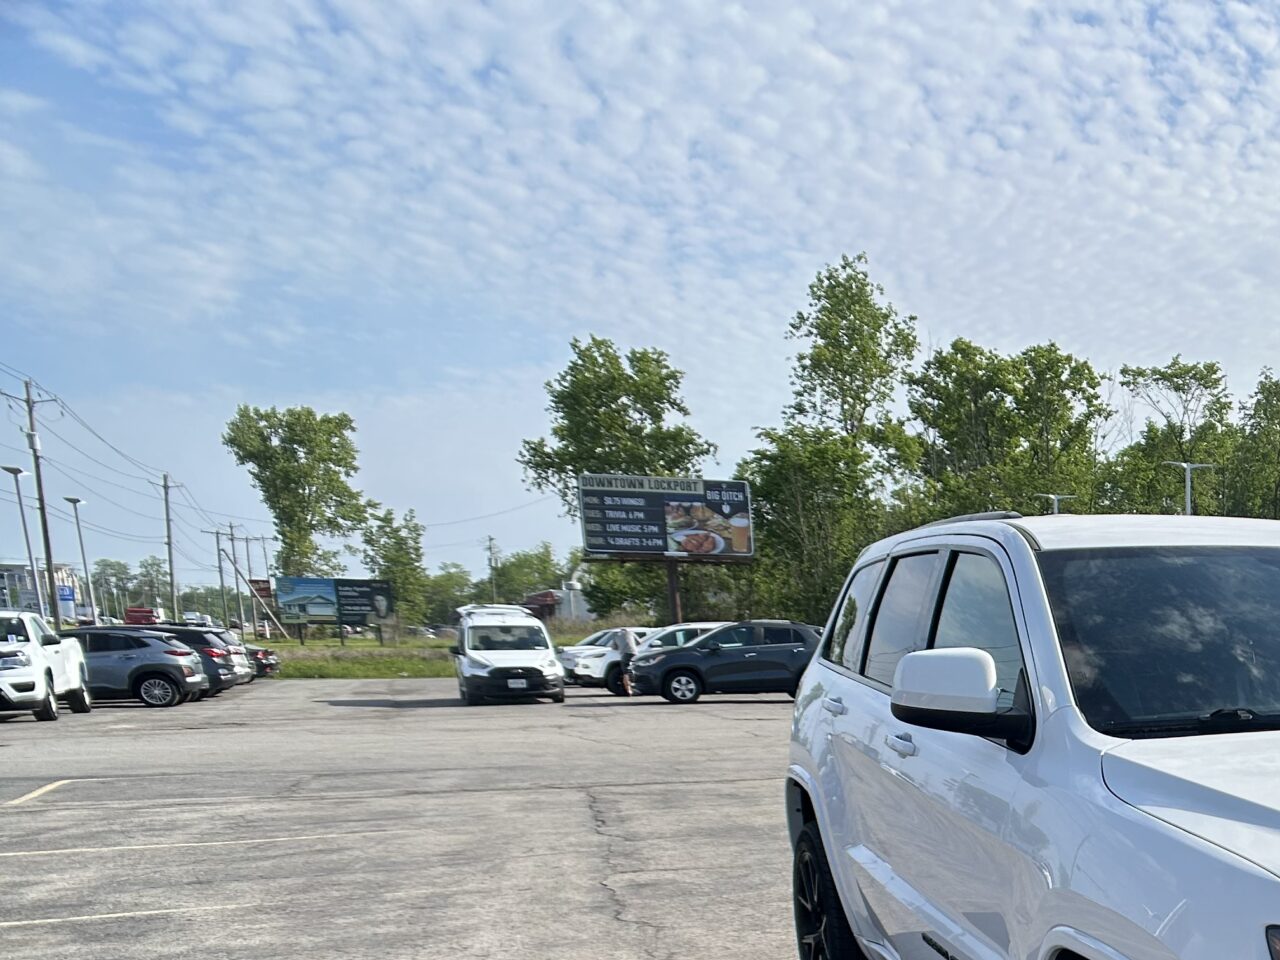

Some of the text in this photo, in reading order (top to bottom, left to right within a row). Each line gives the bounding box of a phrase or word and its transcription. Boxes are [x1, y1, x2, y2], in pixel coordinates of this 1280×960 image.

[582, 476, 700, 492] DOWNTOWN LOCKPORT
[706, 490, 744, 501] BIG DITCH
